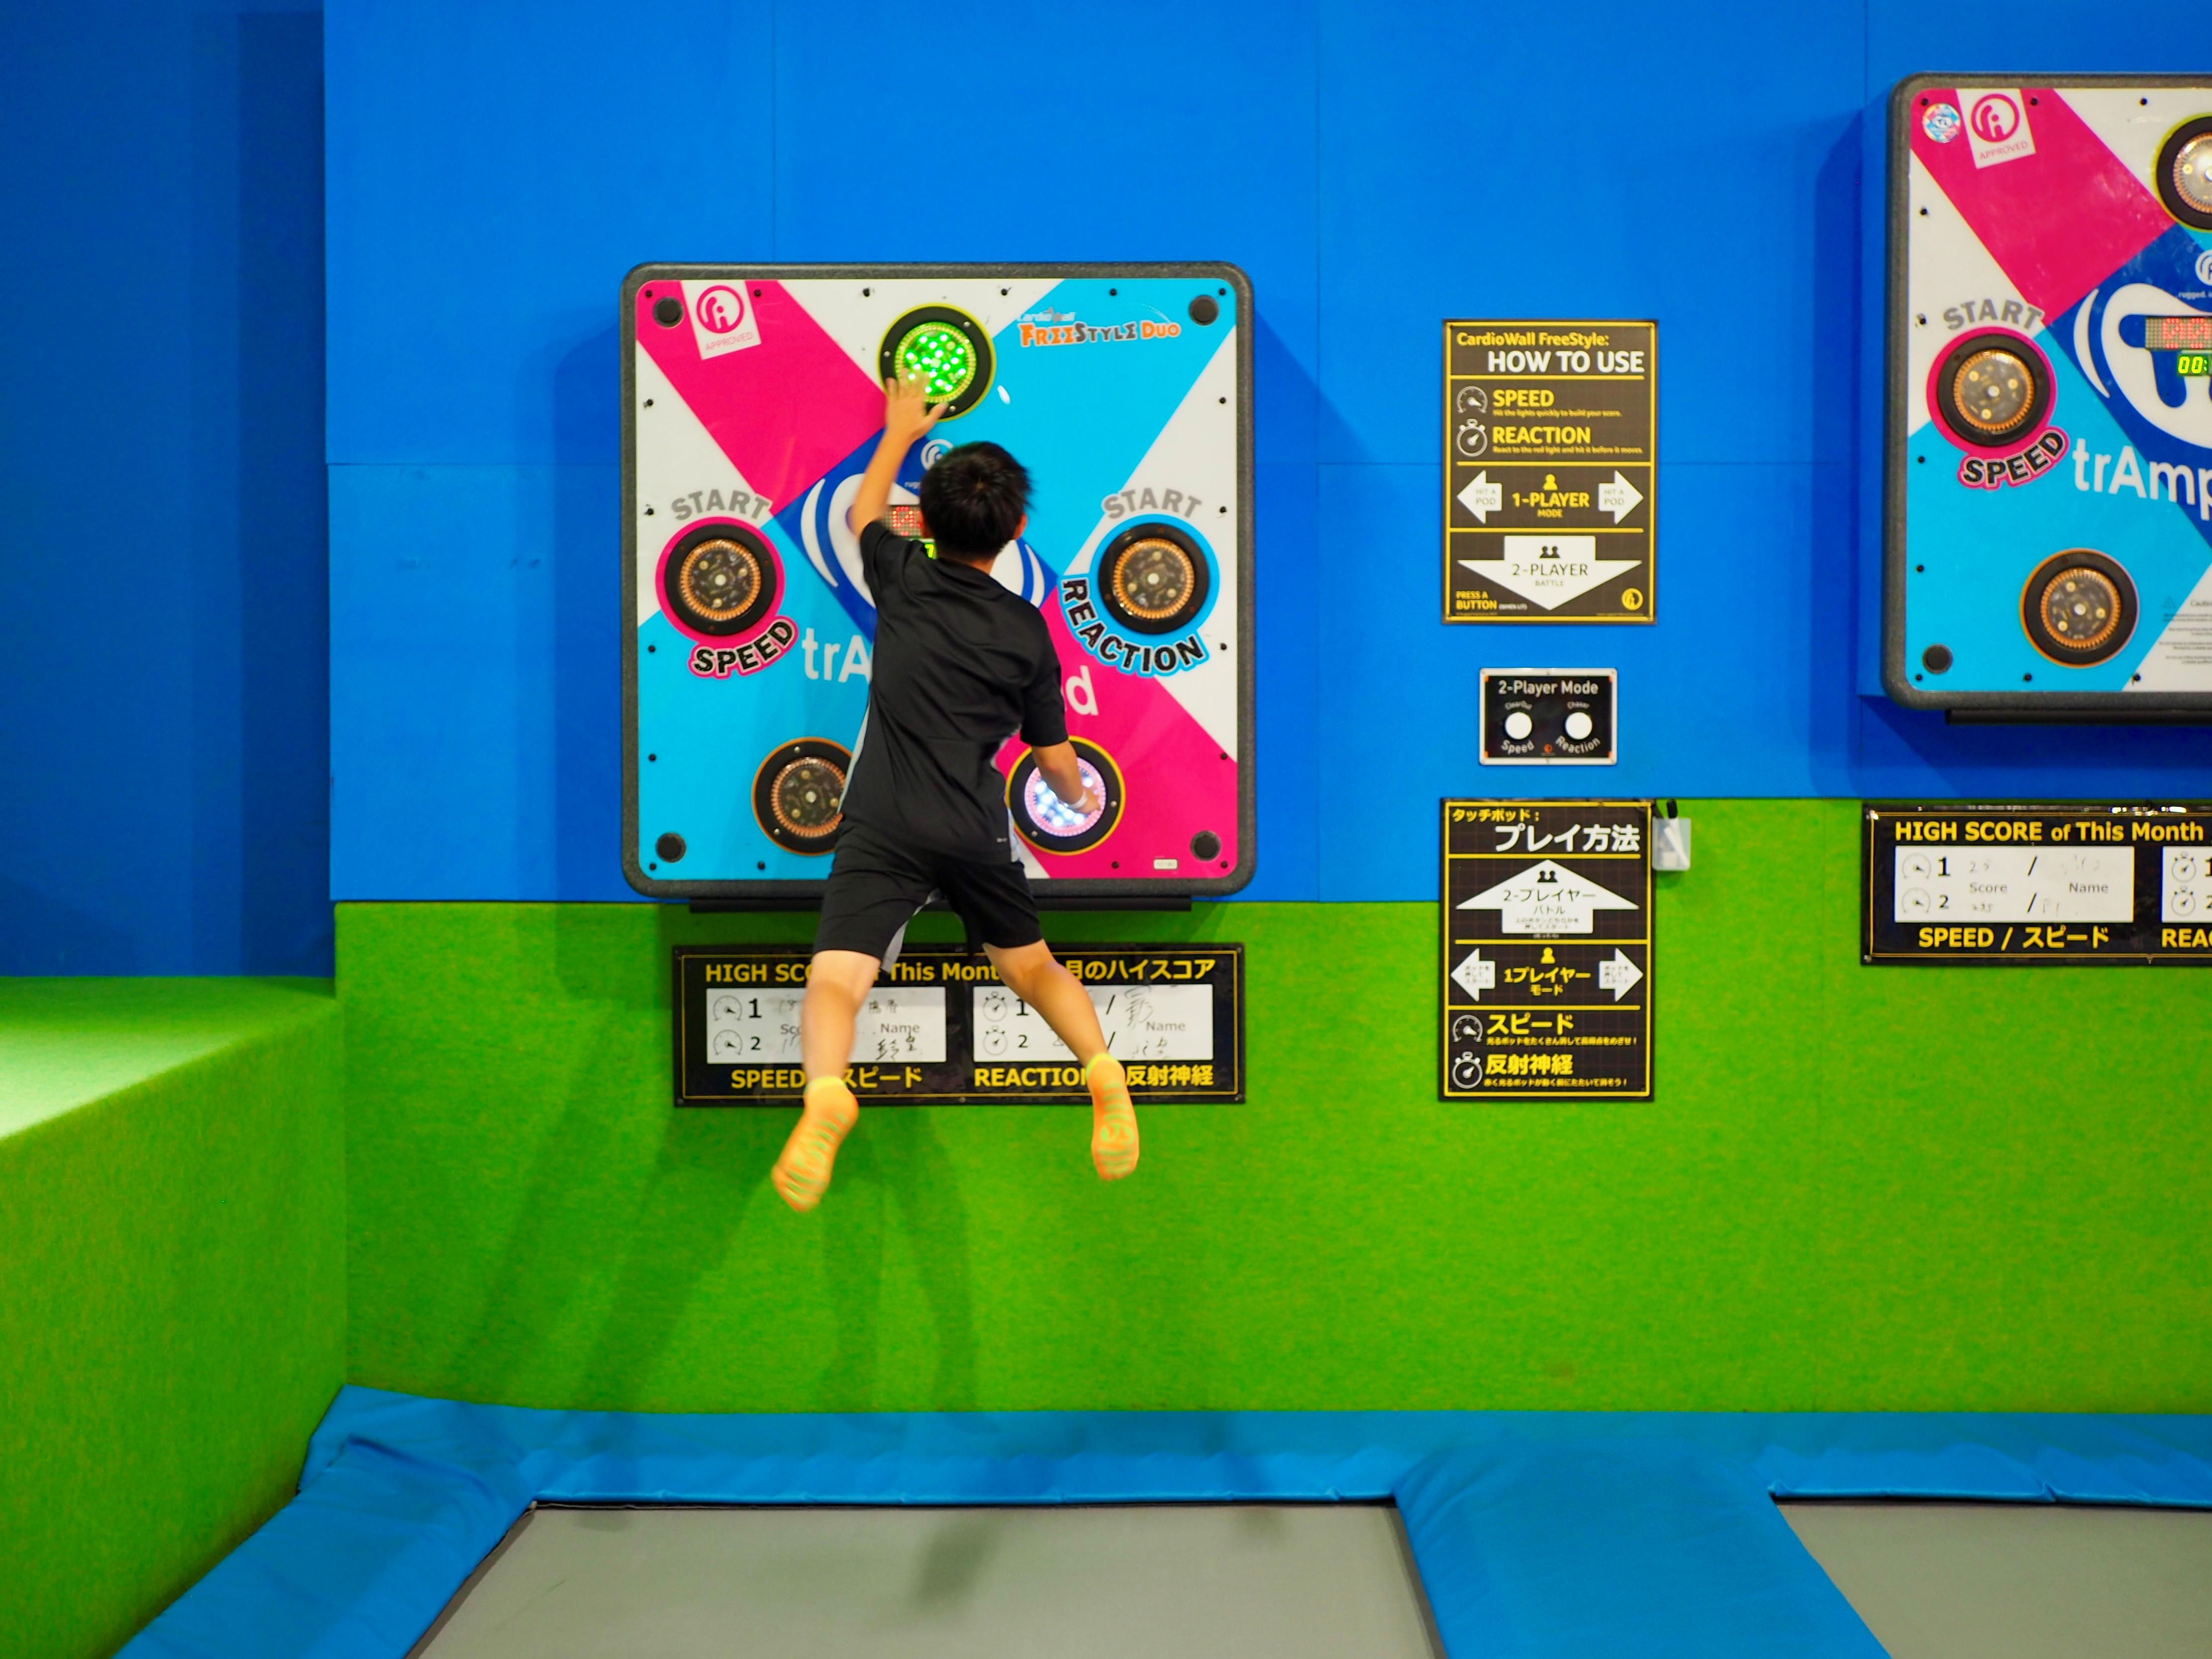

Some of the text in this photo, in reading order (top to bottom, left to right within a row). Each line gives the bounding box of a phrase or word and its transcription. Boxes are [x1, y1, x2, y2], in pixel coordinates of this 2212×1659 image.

[1943, 298, 2043, 330] START
[1457, 332, 1609, 350] CardioWall FreeStyle:
[1488, 351, 1645, 373] HOW TO USE
[1493, 389, 1555, 407] SPEED
[1493, 426, 1591, 444] REACTION
[1963, 431, 2064, 486] SPEED
[671, 488, 771, 521] START
[1103, 487, 1202, 520] START
[1512, 492, 1590, 508] 1-PLAYER
[1537, 509, 1564, 518] MODE
[1512, 563, 1588, 576] 2-PLAYER
[1456, 591, 1488, 599] PRESS A
[1456, 600, 1497, 610] BUTTON
[1063, 579, 1204, 672] REACTION
[693, 621, 795, 673] SPEED
[1498, 680, 1599, 698] 2-Player Mode
[1501, 739, 1535, 754] Speed
[1556, 735, 1601, 754] Reaction
[1495, 824, 1641, 852] プレイ方法
[1896, 820, 2204, 841] HIGH SCORE of This Month
[1938, 857, 1951, 877] 1
[1969, 882, 2109, 893] Score Name
[1534, 906, 1565, 915] バトル
[1939, 895, 1949, 910] 2
[1919, 927, 1994, 948] SPEED
[2023, 924, 2109, 949] スピード
[2162, 928, 2212, 948] REA
[706, 964, 767, 982] HIGH
[891, 962, 935, 981] This
[942, 962, 1000, 981] Mont
[1504, 967, 1591, 984] 1プレイヤー
[1530, 984, 1564, 996] モード
[748, 999, 762, 1018] 1
[1016, 999, 1029, 1016] 1
[881, 1023, 920, 1033] Name
[1146, 1021, 1186, 1031] Name
[1487, 1013, 1574, 1035] スピード
[750, 1037, 761, 1050] 2
[1018, 1034, 1028, 1048] 2
[1485, 1053, 1573, 1075] 反射神経
[732, 1070, 807, 1089] SPEED
[1126, 1064, 1214, 1086] 反射神経
